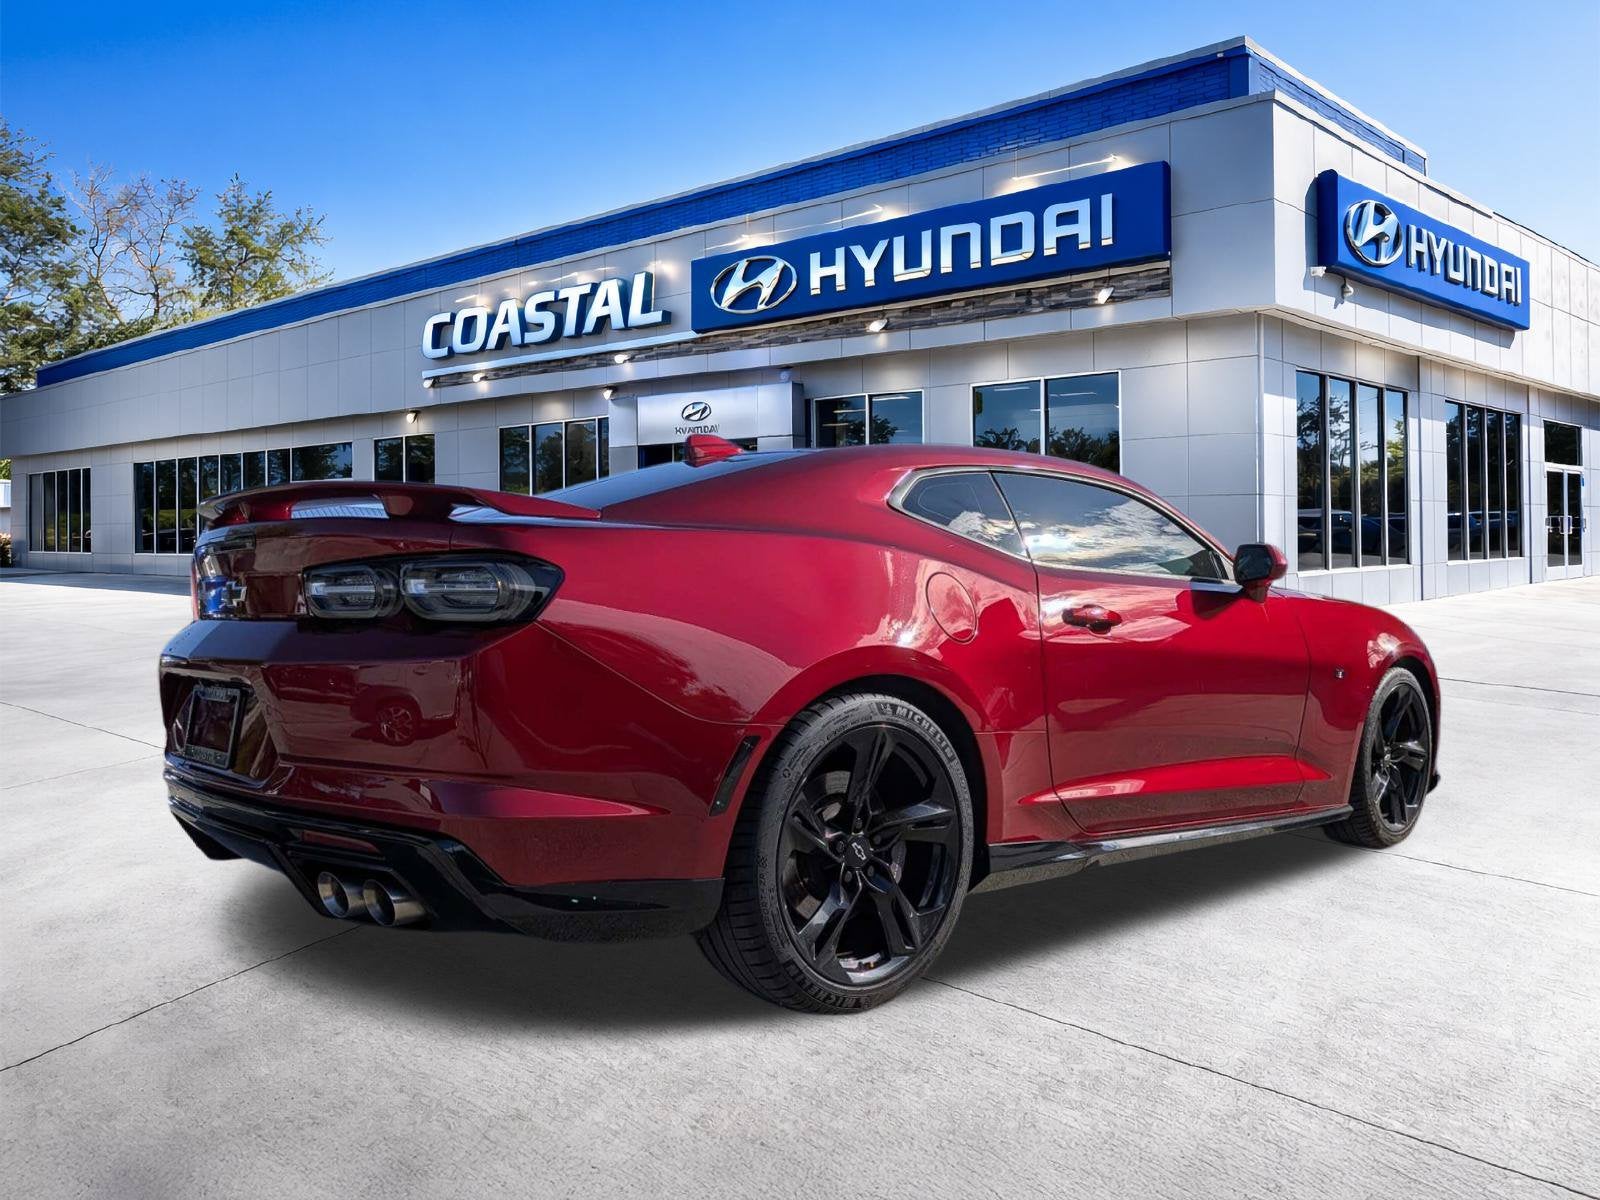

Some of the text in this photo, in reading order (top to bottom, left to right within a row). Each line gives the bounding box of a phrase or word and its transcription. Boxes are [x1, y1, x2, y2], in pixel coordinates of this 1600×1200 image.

[809, 192, 1114, 297] HYUNDAI
[1405, 224, 1523, 307] HYUNDAI
[421, 271, 668, 360] COASTAL
[895, 705, 957, 759] MICHELIN
